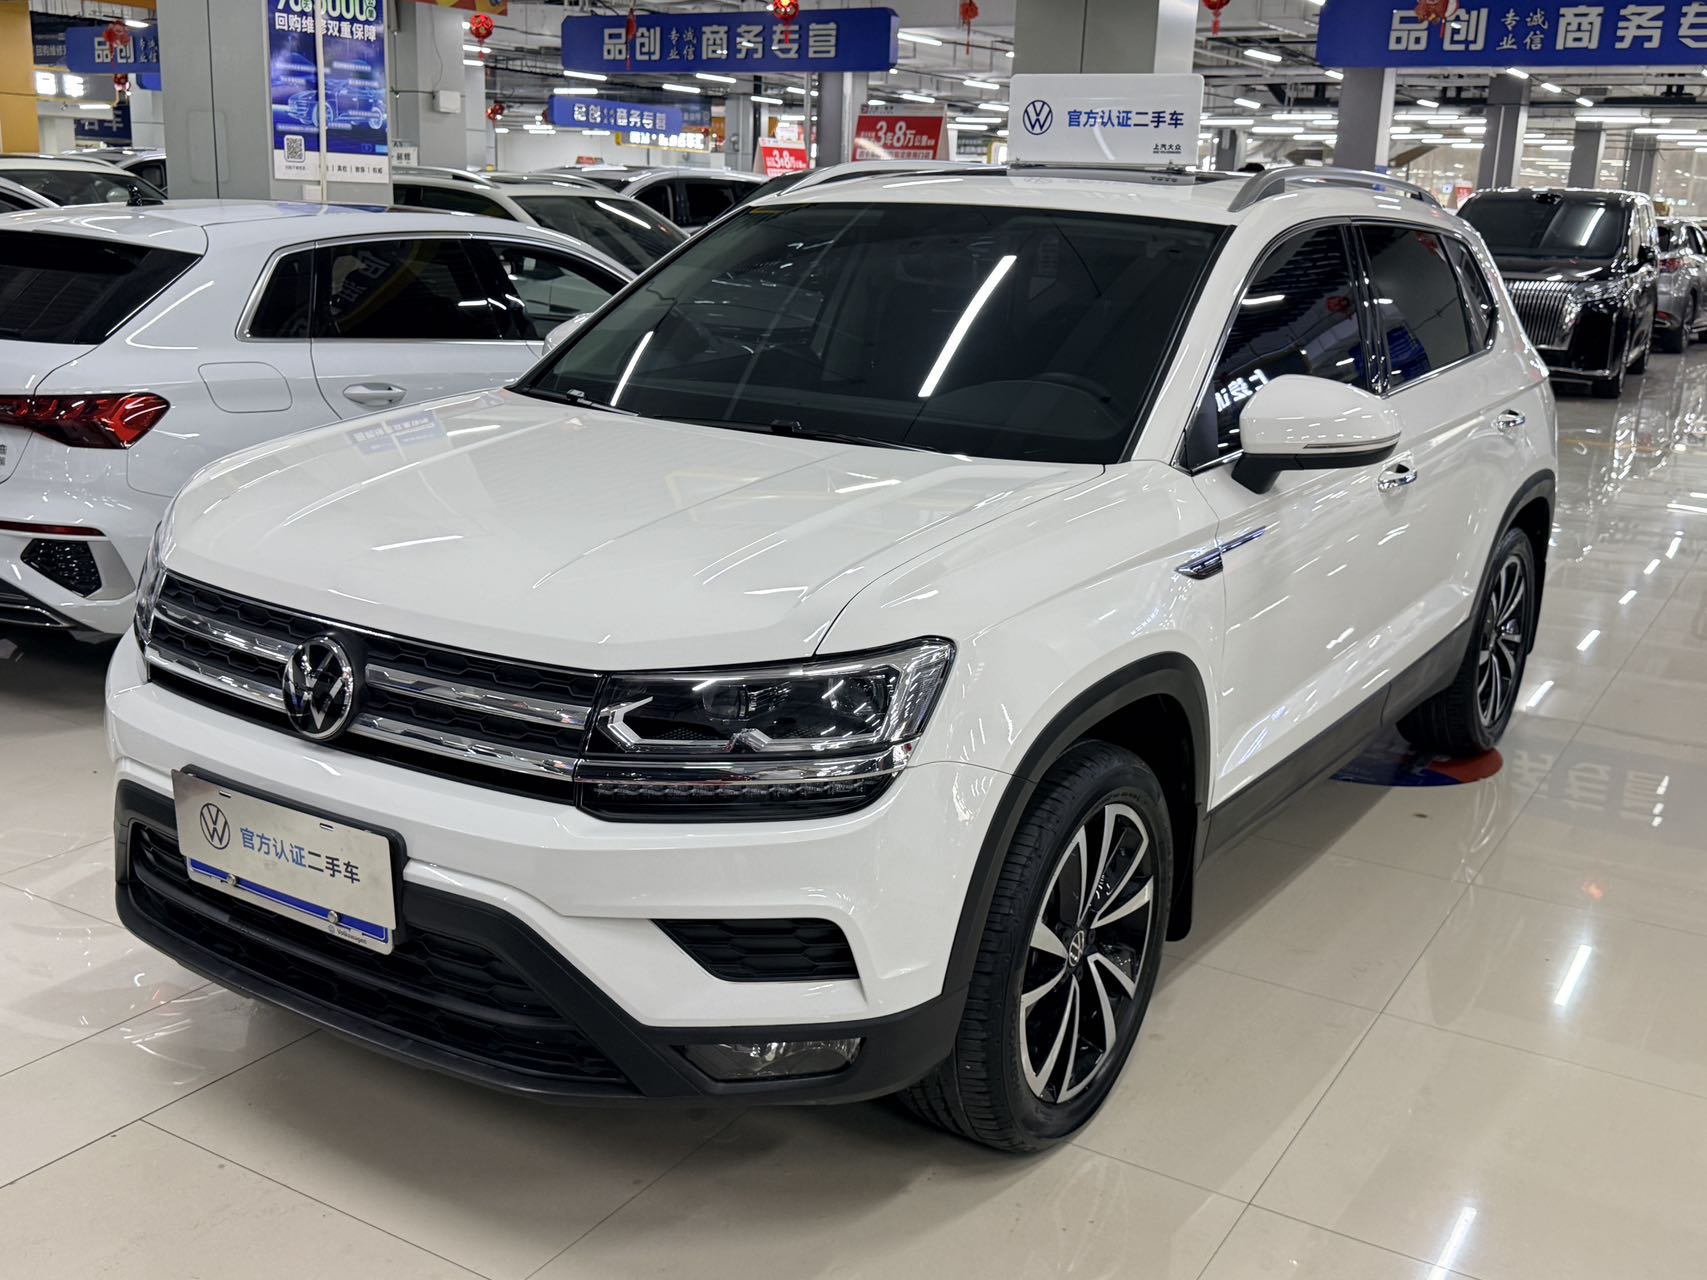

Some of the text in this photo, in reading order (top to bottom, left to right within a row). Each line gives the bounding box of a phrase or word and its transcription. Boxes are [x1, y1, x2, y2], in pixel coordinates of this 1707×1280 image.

[603, 27, 660, 61] 品创
[702, 22, 837, 60] 商务专营
[1388, 8, 1488, 51] 品创
[1067, 109, 1185, 129] 官方认证二手车
[240, 827, 361, 885] 官方认证二手车
